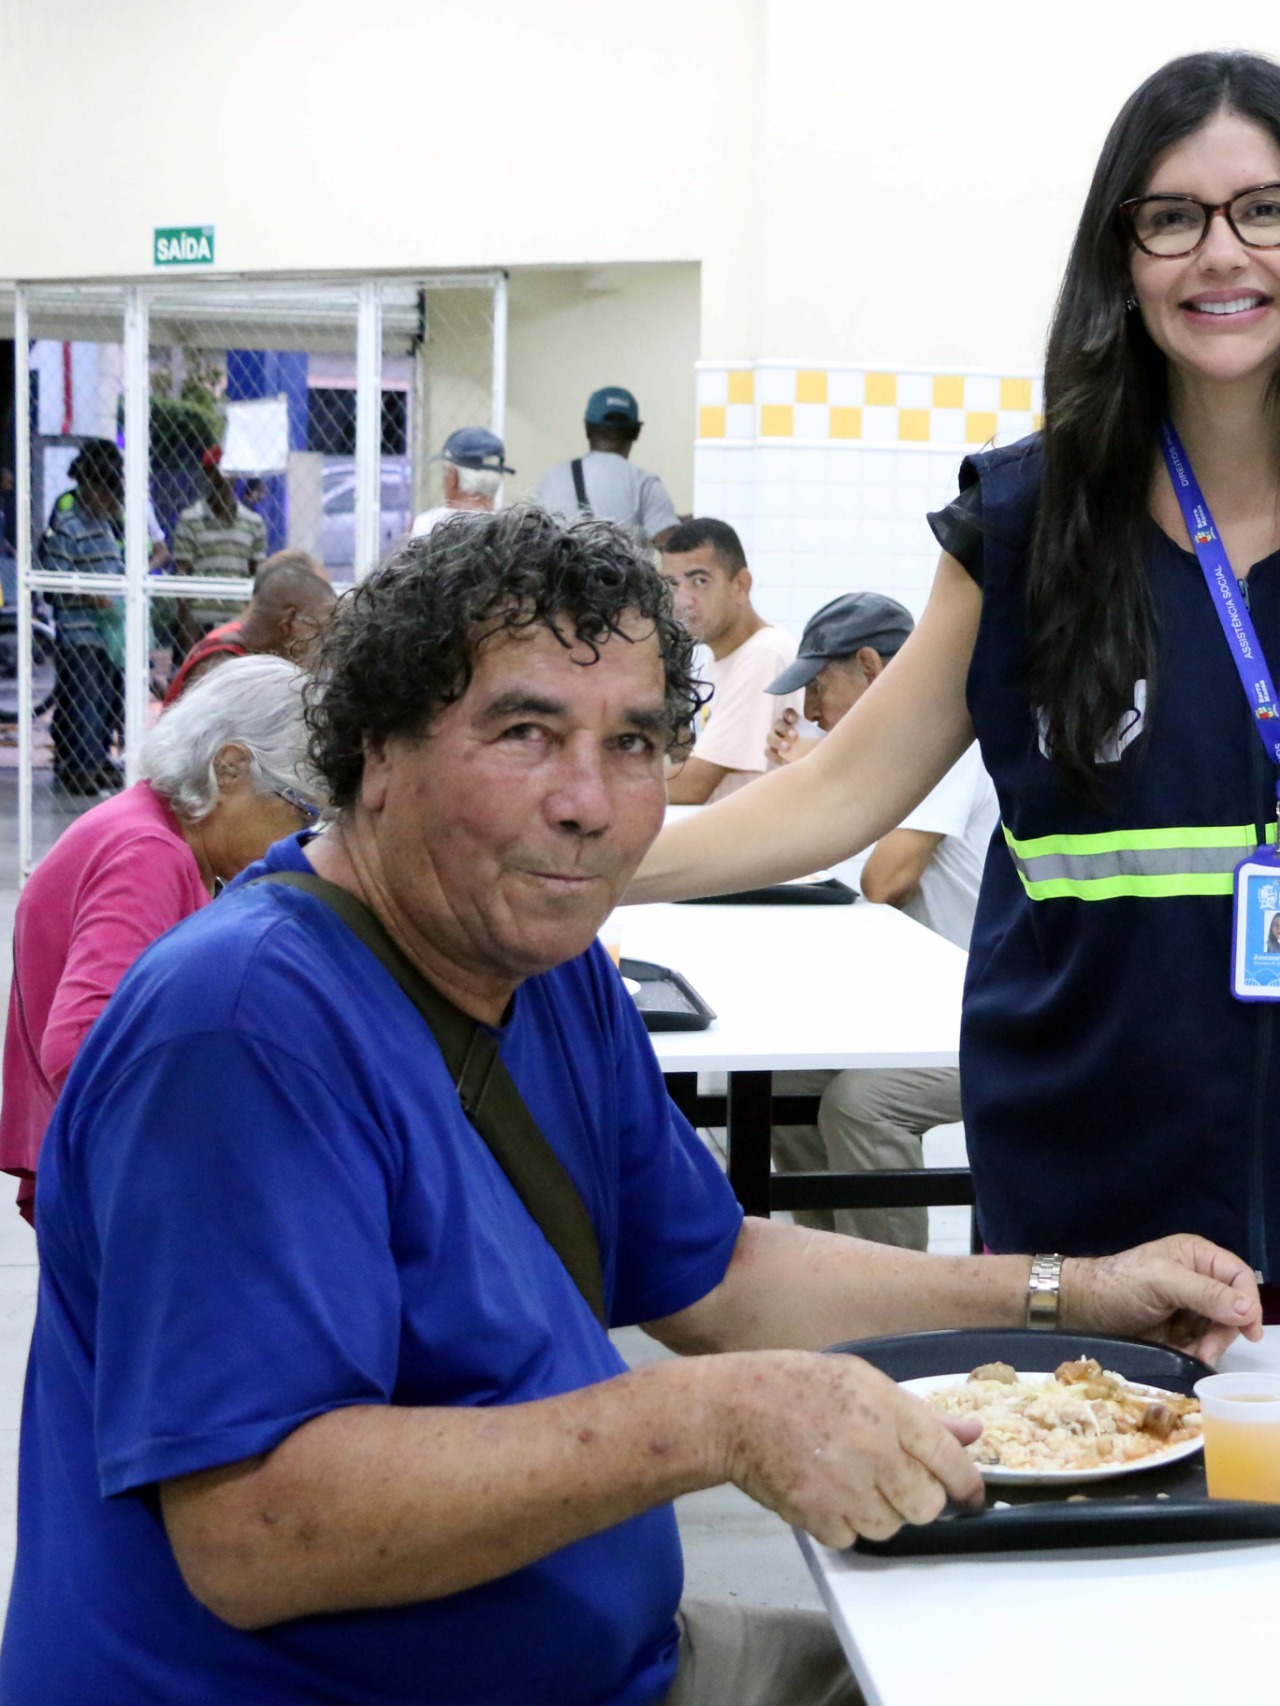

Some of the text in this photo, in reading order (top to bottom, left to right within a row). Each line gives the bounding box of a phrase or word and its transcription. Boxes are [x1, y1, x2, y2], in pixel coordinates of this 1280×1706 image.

[157, 231, 212, 261] SAÍDA
[1169, 446, 1189, 487] DIREITOS
[1214, 565, 1254, 659] ASSISTÊNCIA SOCIAL
